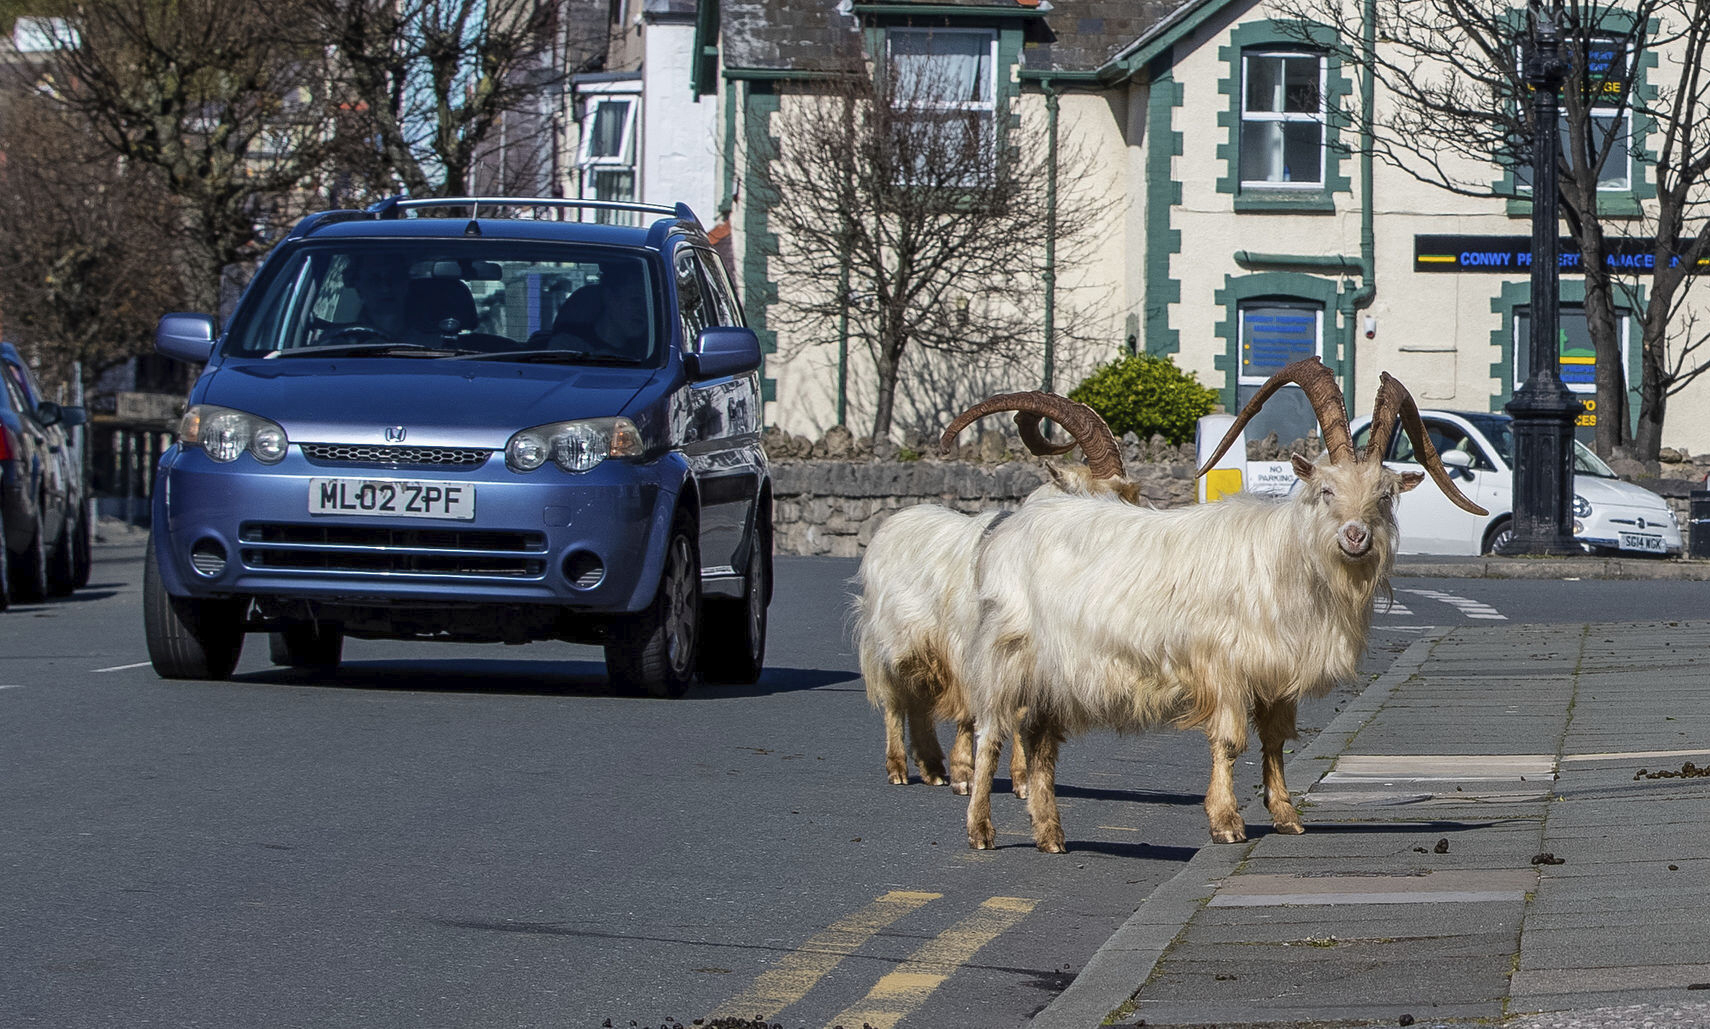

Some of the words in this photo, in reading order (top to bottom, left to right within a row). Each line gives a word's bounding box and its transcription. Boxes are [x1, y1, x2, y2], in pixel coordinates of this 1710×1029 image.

[1460, 251, 1511, 266] CONWY
[1269, 465, 1283, 473] NO
[1258, 473, 1294, 482] PARKING
[320, 483, 396, 511] ML02
[405, 486, 462, 514] ZPF
